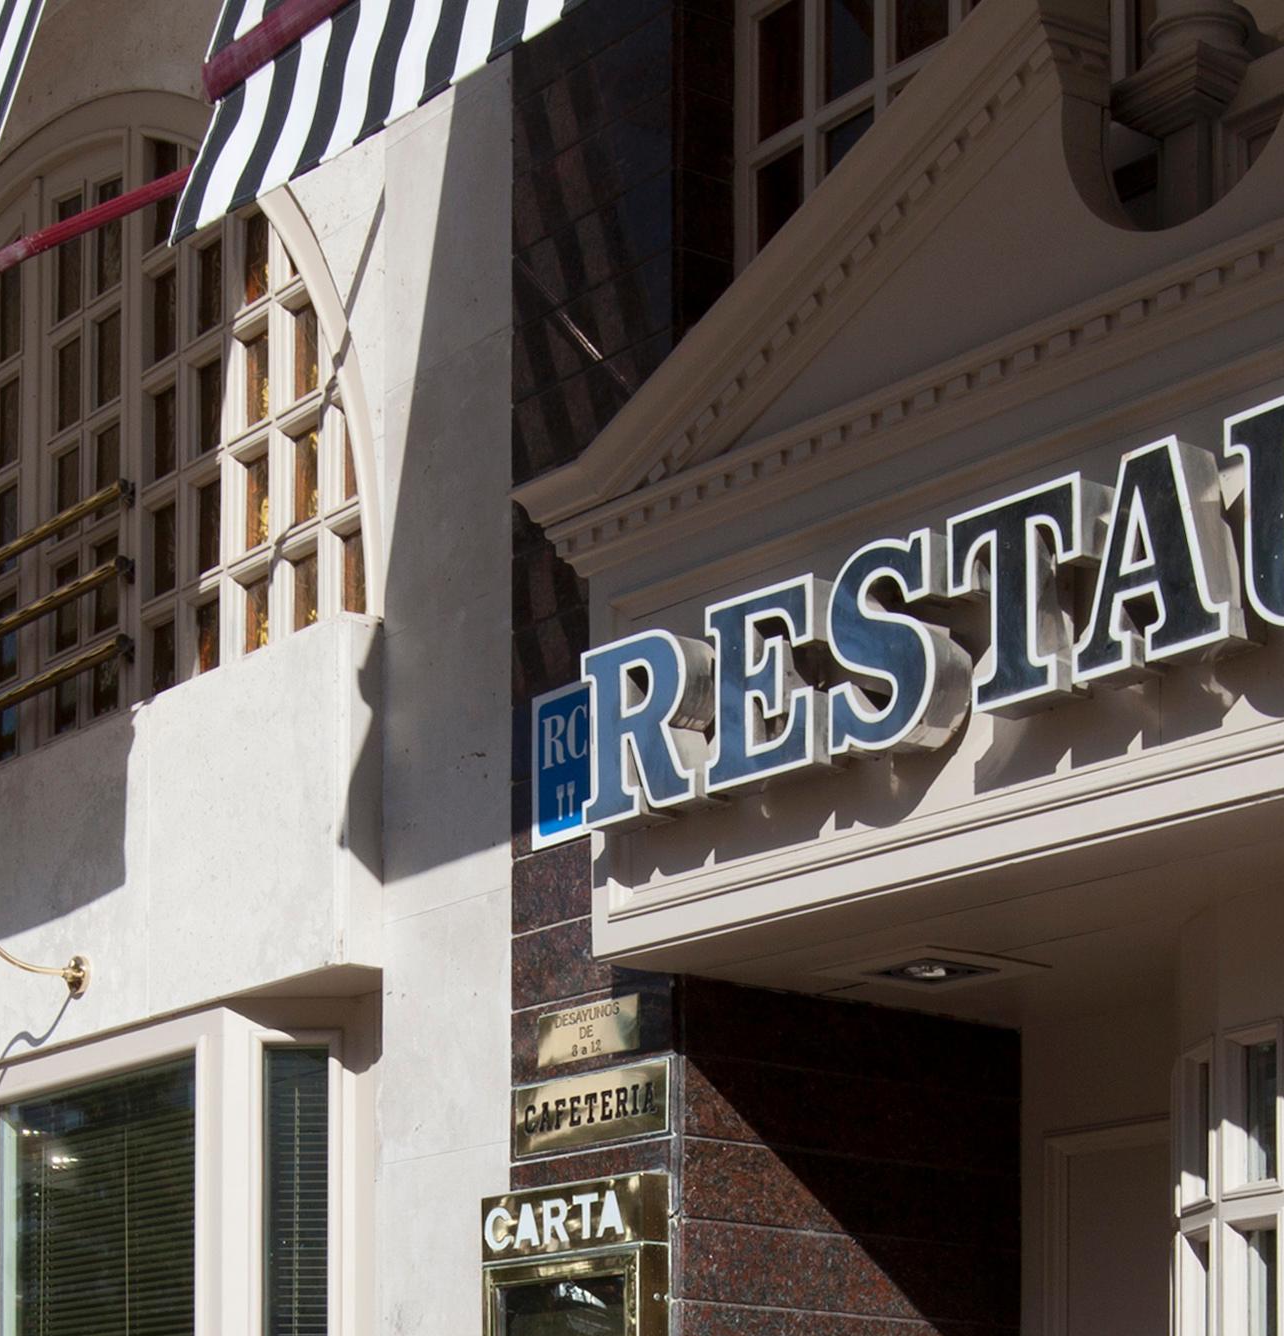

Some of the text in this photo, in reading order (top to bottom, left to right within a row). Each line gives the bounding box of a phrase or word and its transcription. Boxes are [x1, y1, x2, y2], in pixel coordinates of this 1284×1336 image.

[542, 703, 589, 770] RC
[555, 1001, 620, 1029] DESAYUNOS
[579, 1025, 594, 1040] DE
[571, 1039, 602, 1057] 8 a 12
[524, 1082, 656, 1135] CAFETERIA
[484, 1189, 625, 1253] CARTA
